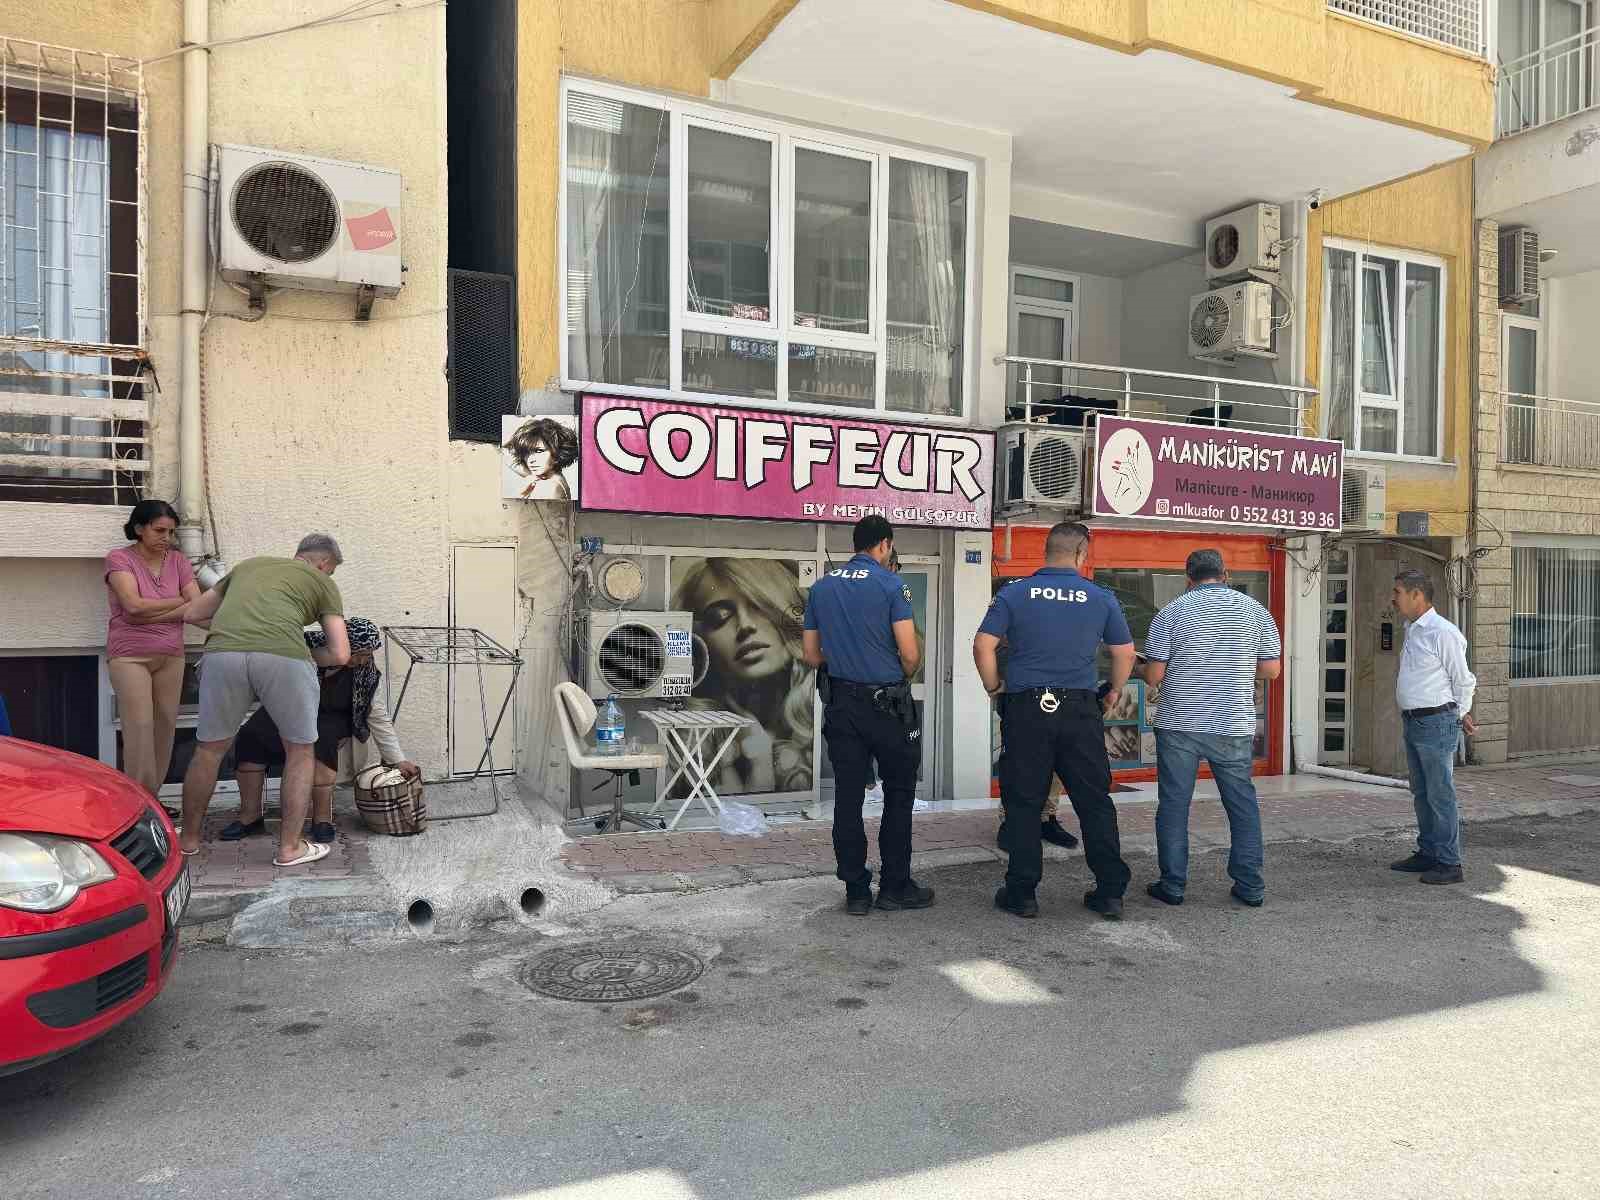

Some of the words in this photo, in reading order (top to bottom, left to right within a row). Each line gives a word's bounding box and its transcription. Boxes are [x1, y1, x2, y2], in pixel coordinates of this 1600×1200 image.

[594, 406, 986, 502] COIFFEUR
[1175, 478, 1239, 497] Manicure
[1251, 485, 1316, 504] Маникюр
[803, 503, 826, 517] BY
[1172, 502, 1225, 519] mlkuafor
[1230, 505, 1239, 520] 0
[1243, 506, 1268, 522] 552
[1271, 508, 1296, 525] 431
[1300, 510, 1316, 526] 39
[1319, 512, 1335, 527] 36
